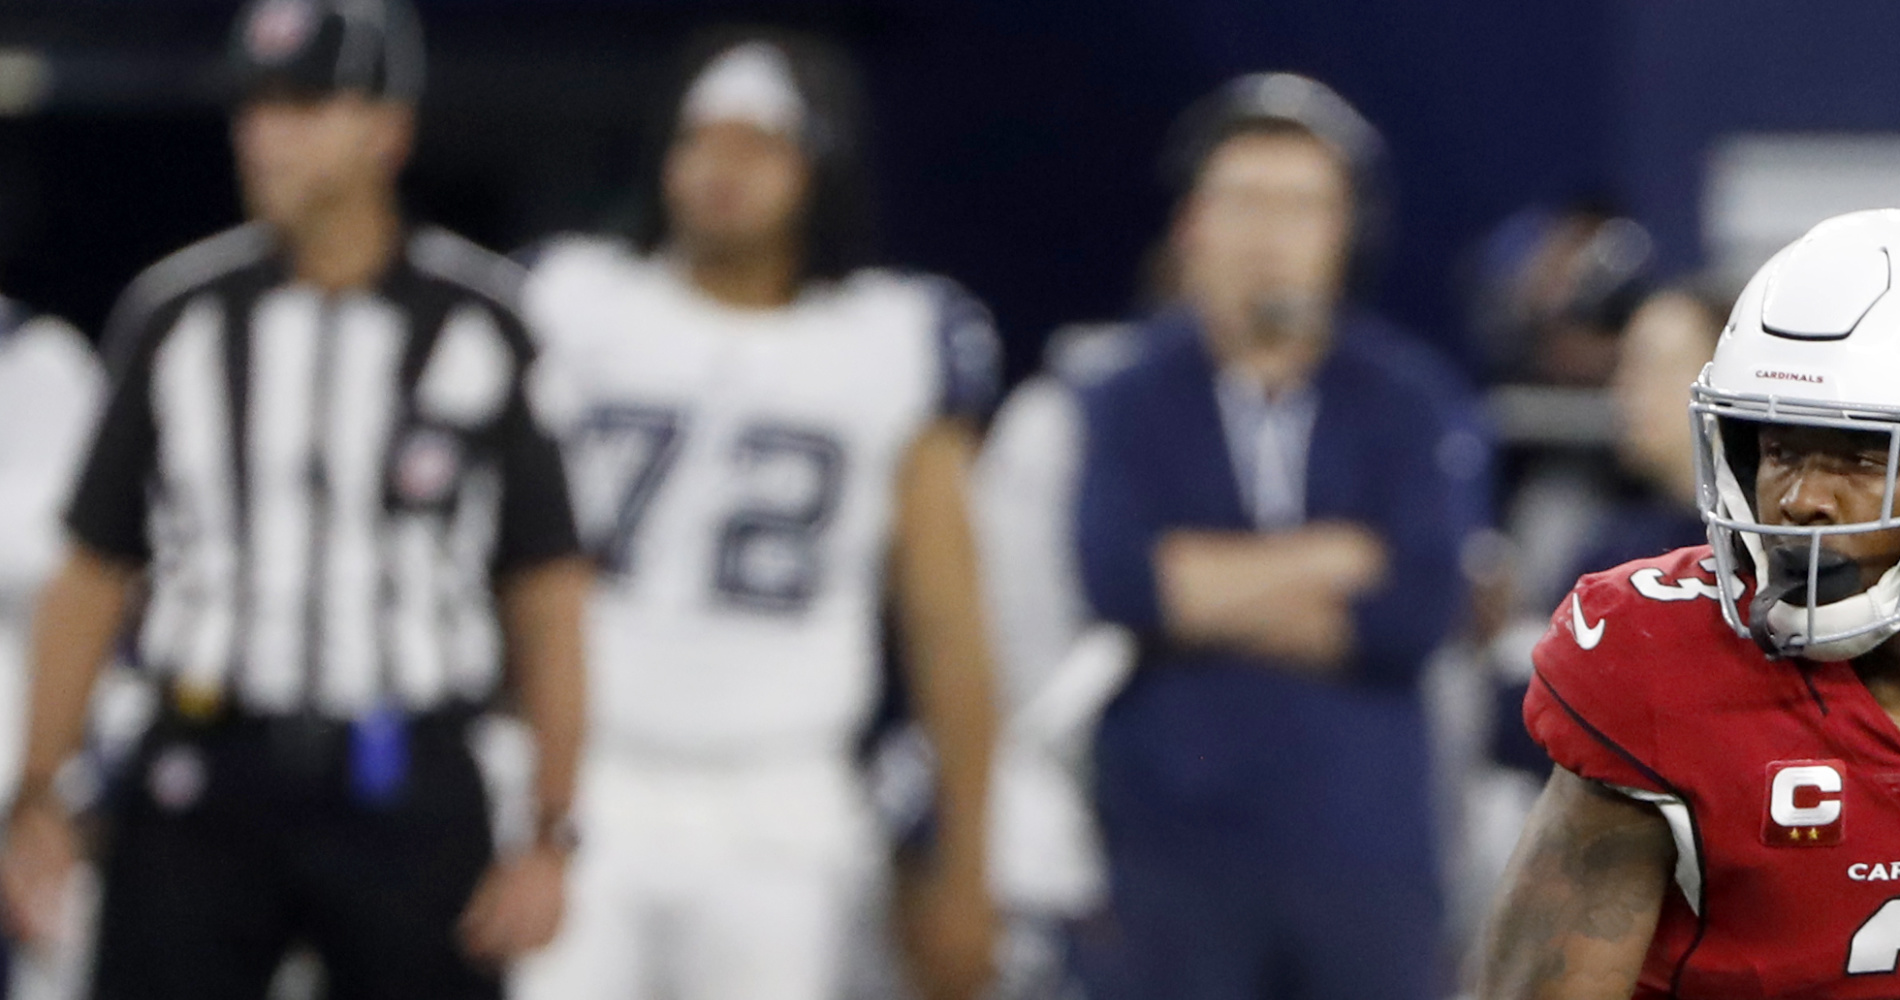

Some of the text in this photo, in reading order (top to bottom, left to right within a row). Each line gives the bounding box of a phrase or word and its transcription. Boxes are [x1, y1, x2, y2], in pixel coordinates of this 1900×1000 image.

[1754, 369, 1824, 384] CARDINALS
[560, 398, 850, 614] 72
[1769, 764, 1843, 827] C
